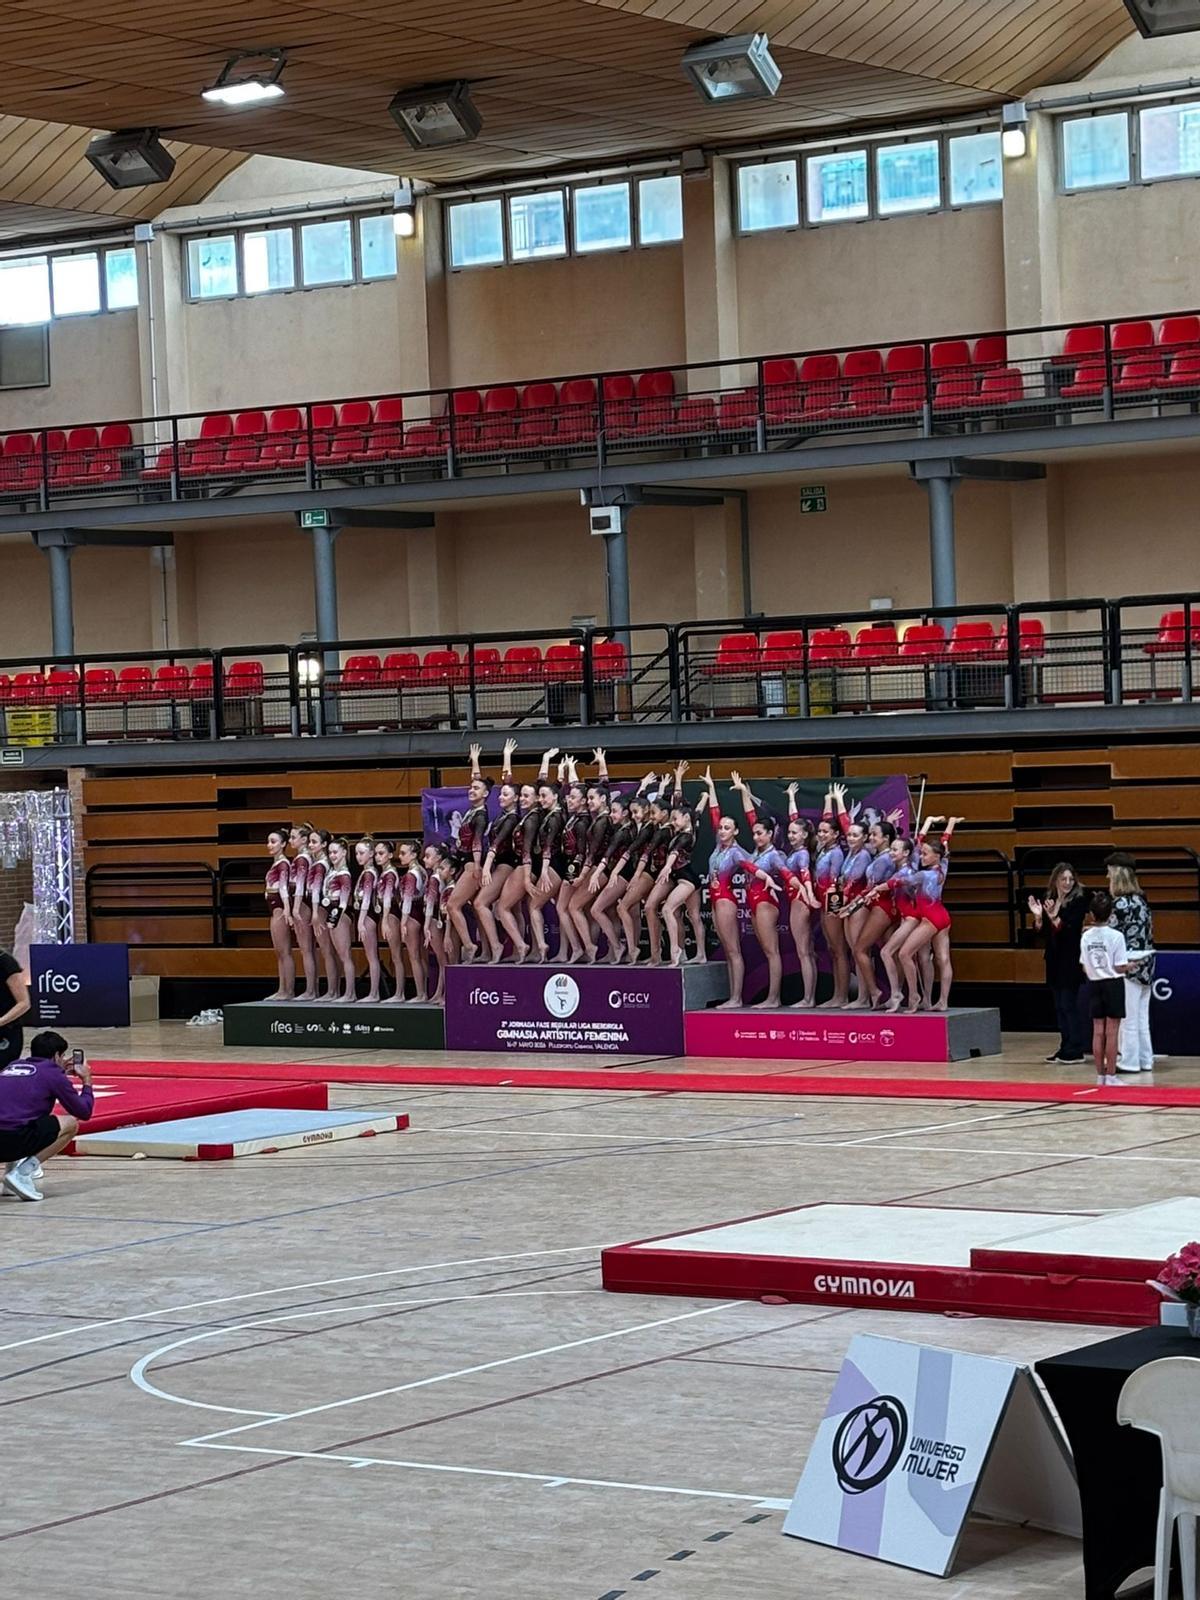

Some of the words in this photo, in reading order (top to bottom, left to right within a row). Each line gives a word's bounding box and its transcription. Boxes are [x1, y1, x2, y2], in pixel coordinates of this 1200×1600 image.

[622, 992, 650, 1003] FGCV
[536, 1021, 550, 1029] FASE
[496, 1029, 539, 1039] GIMNASIA
[539, 1028, 584, 1041] ARTÍSTICA
[584, 1031, 629, 1042] FEMENINA
[813, 1274, 915, 1298] GYMNOVA
[909, 1436, 967, 1461] UNIVERSO
[901, 1453, 960, 1483] MUJER
